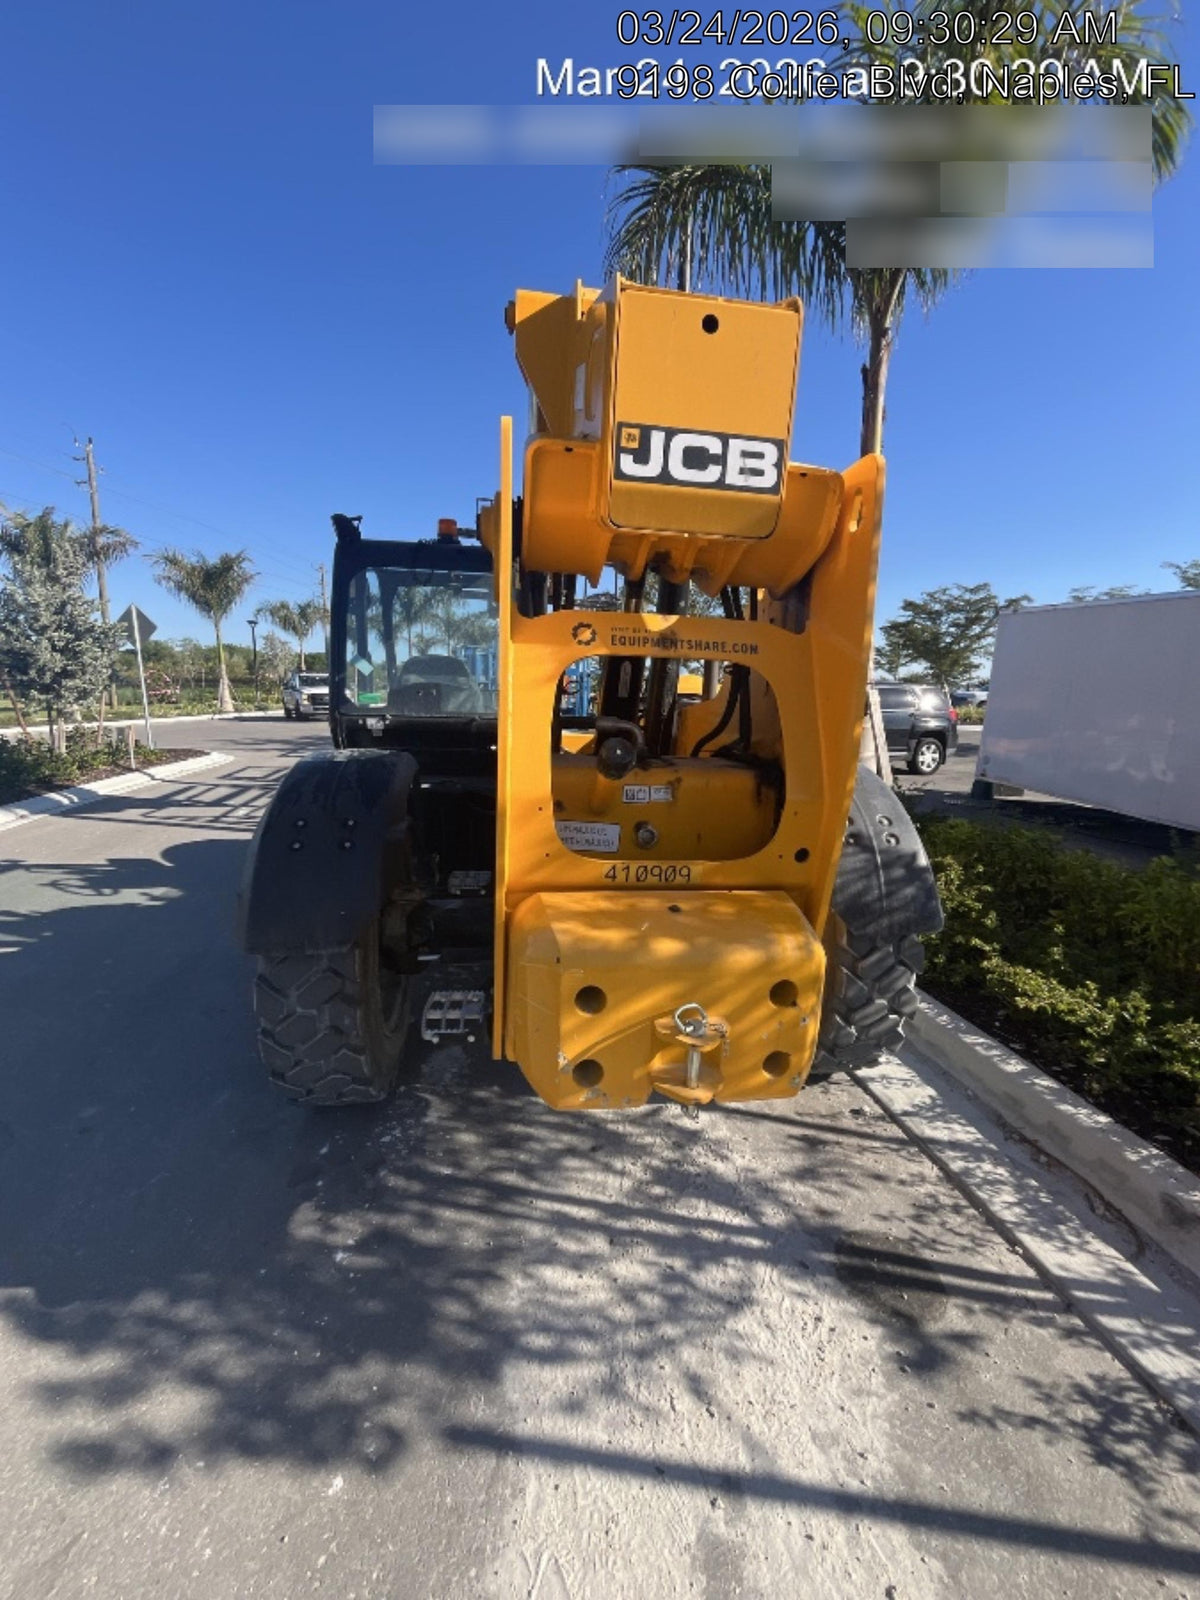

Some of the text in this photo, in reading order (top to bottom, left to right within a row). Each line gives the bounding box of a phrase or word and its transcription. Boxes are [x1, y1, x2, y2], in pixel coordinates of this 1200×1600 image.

[619, 430, 779, 488] JCB
[610, 634, 760, 655] EQUIPMENTSHARE.COM
[603, 864, 691, 883] 410909
